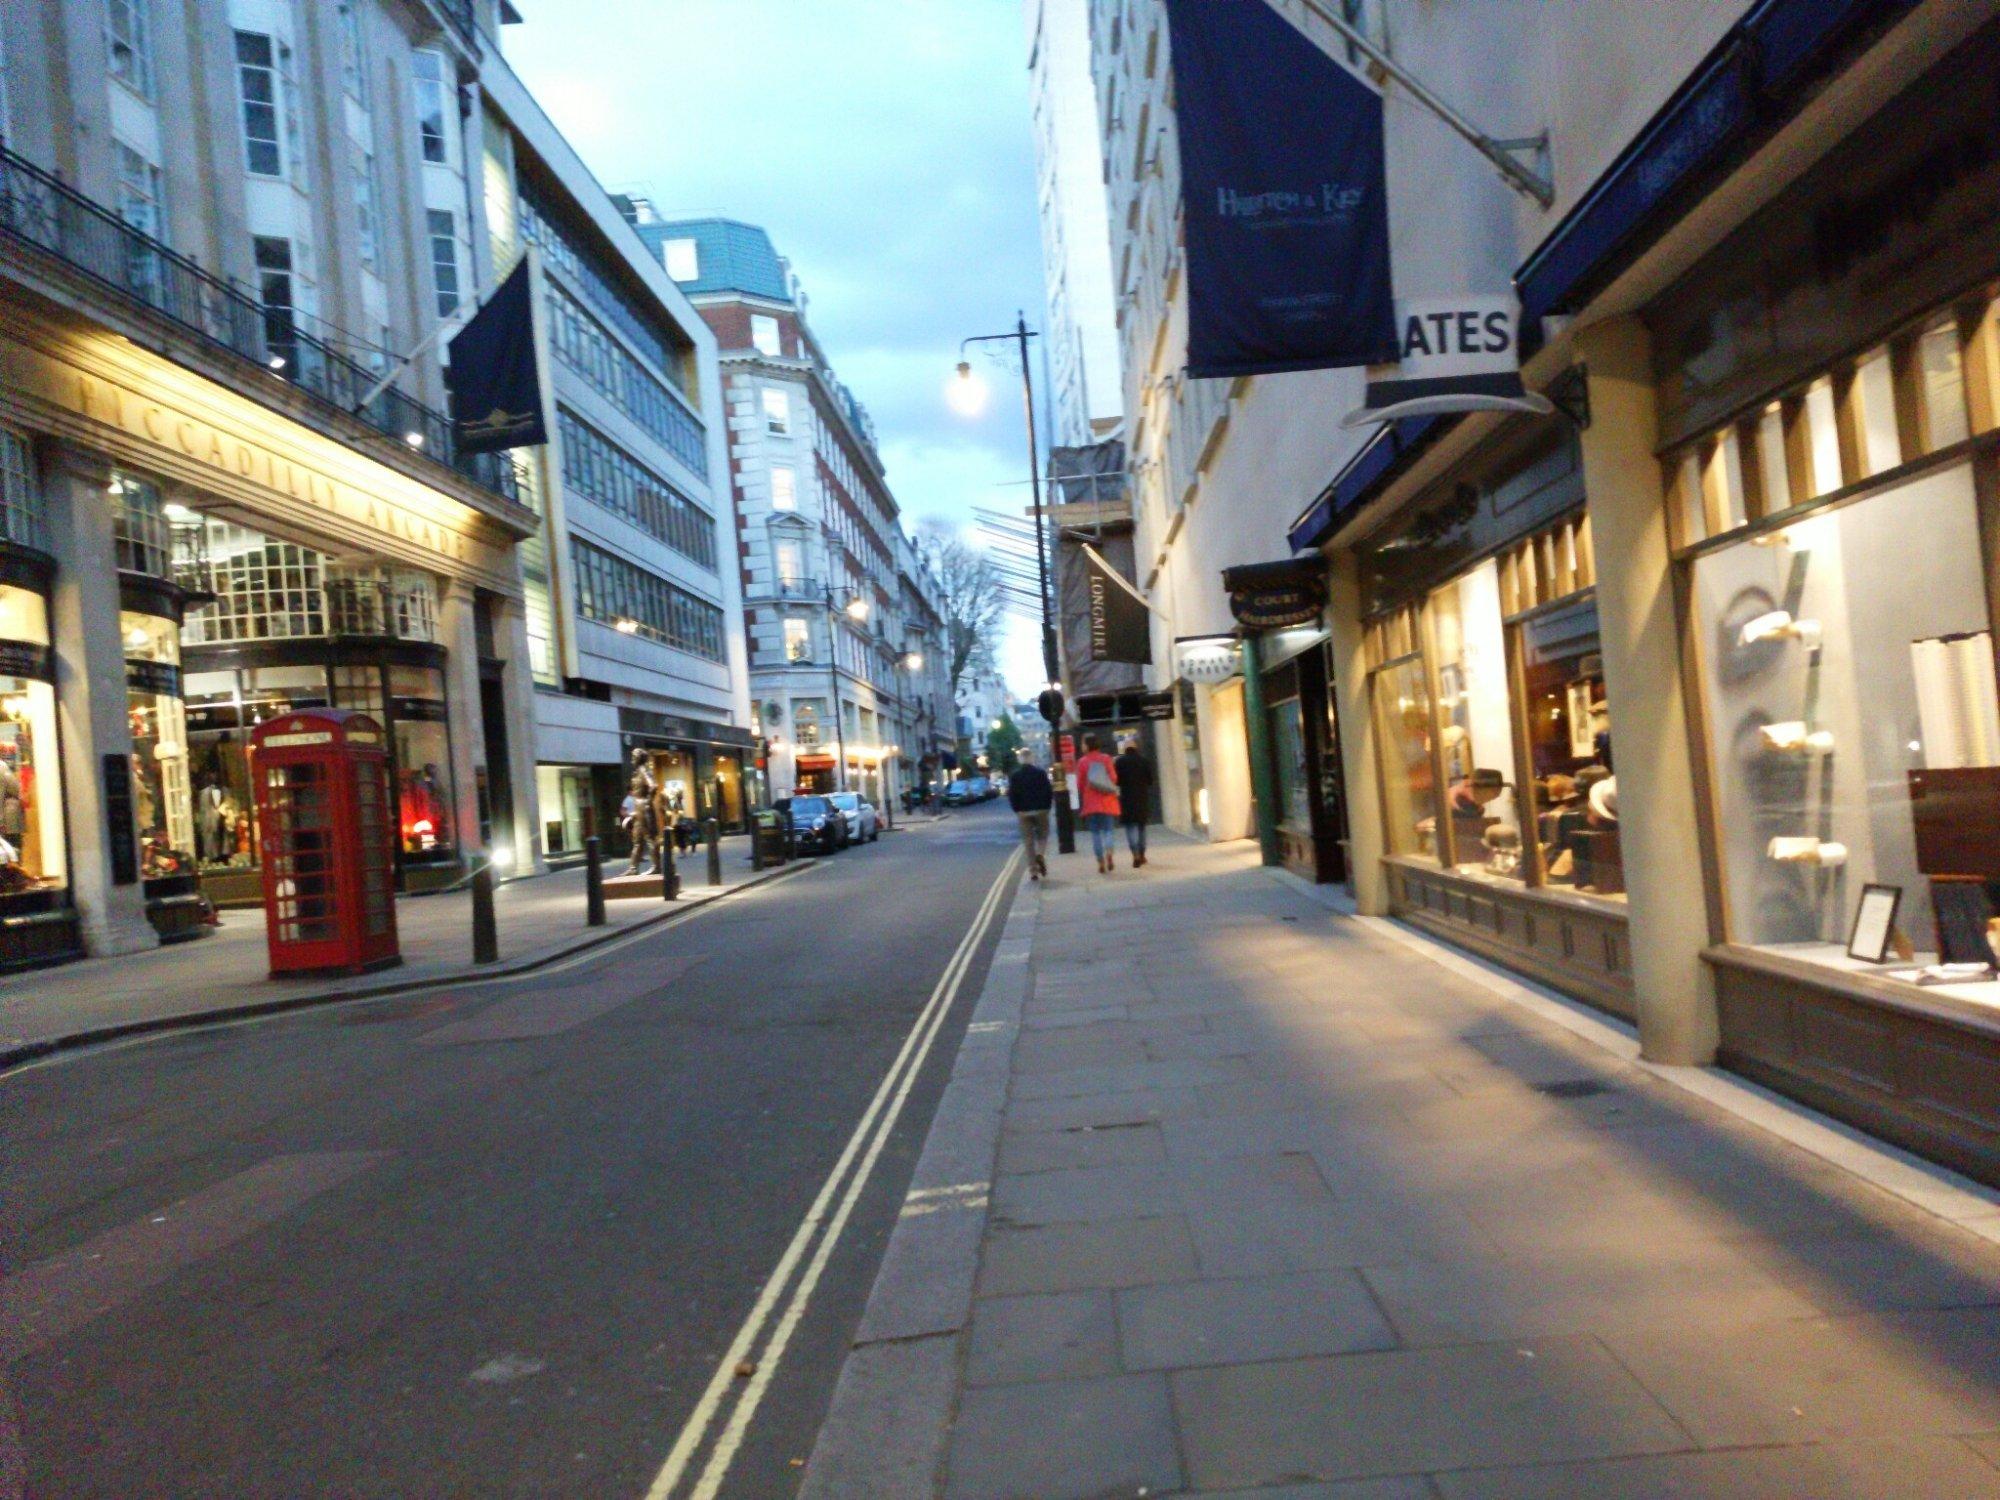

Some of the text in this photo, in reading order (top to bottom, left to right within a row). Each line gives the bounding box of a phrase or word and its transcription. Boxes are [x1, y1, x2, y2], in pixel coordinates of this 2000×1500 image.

[1403, 310, 1509, 358] ATES
[77, 376, 466, 560] PICCADILLY ARCADE
[1091, 575, 1107, 656] LONGMIRE
